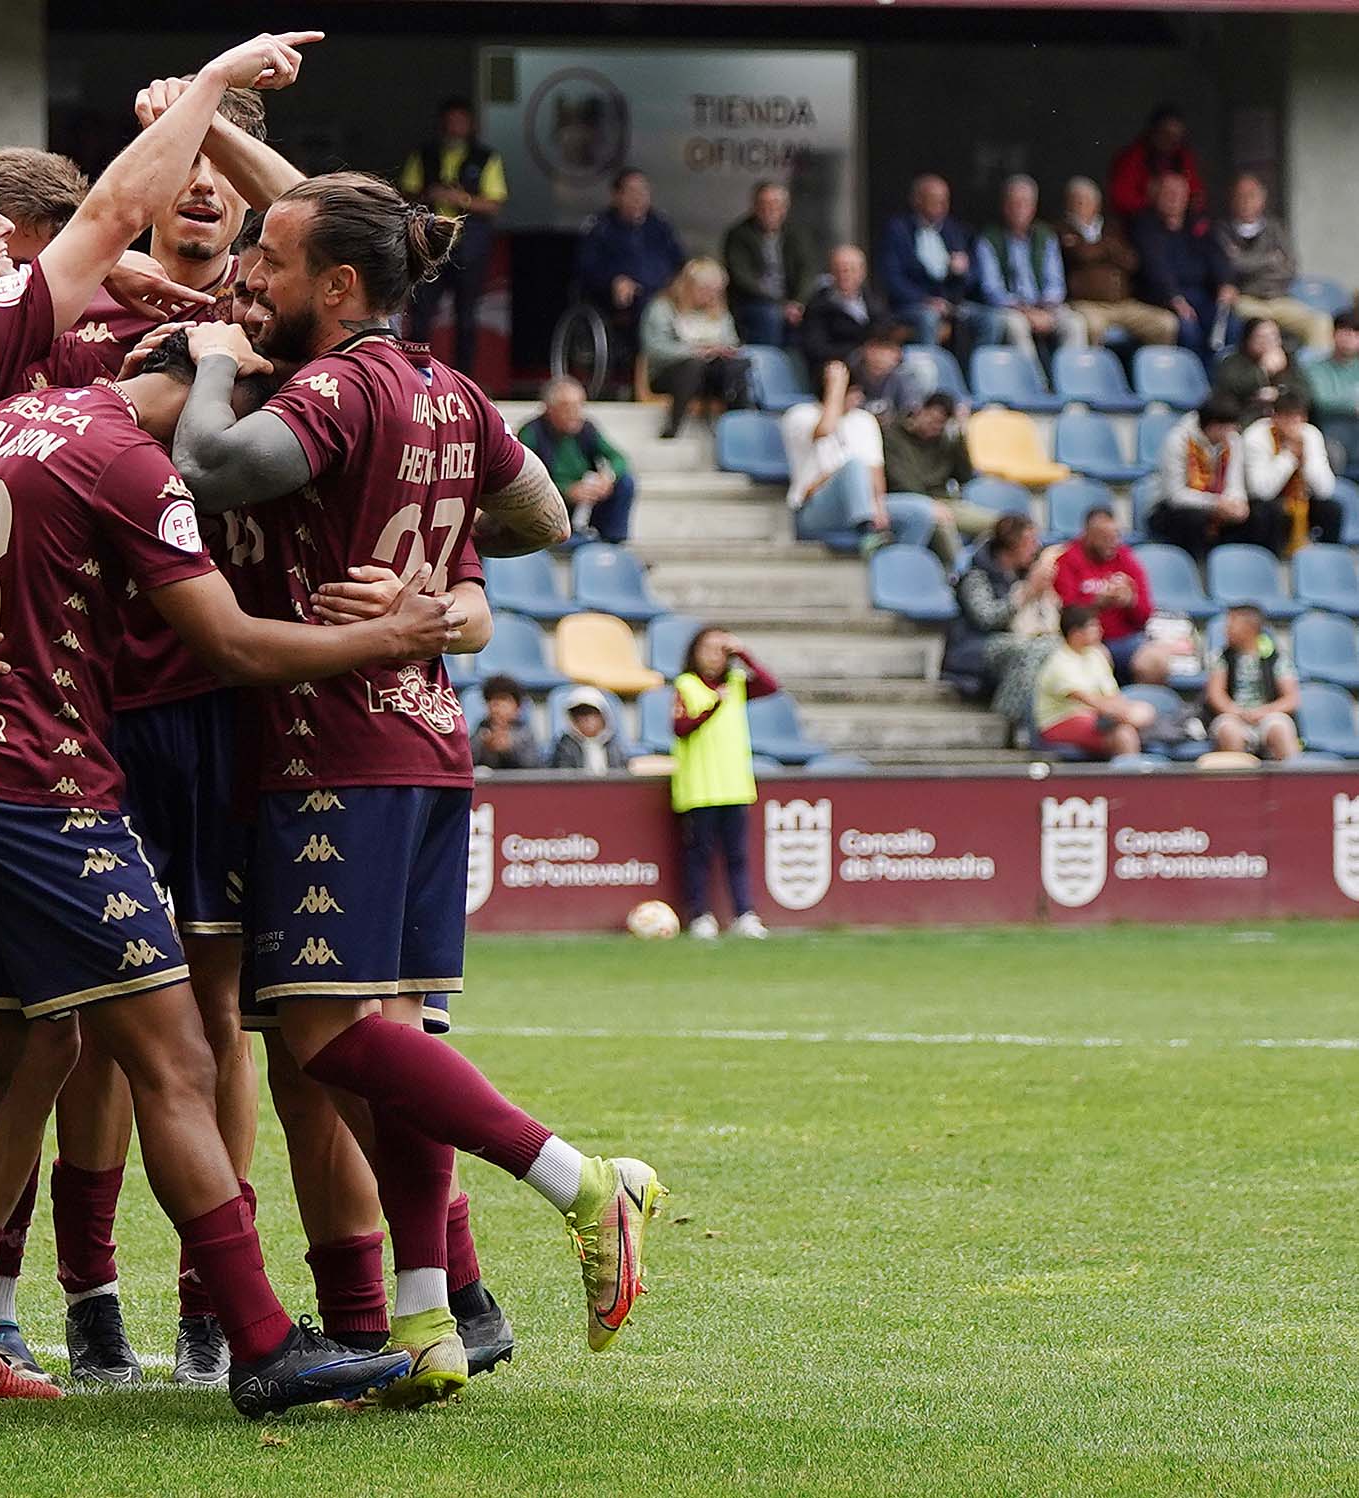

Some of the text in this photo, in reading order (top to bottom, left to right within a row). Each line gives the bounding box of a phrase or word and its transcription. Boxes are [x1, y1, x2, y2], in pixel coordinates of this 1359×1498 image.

[692, 94, 817, 128] TIENDA
[502, 833, 600, 862] Concello
[839, 828, 936, 856] Concello
[1114, 827, 1210, 854] Concello
[502, 859, 659, 888] de Pontevedra
[839, 853, 995, 882] de Pontevedra
[1114, 852, 1268, 880] de Pontevedra
